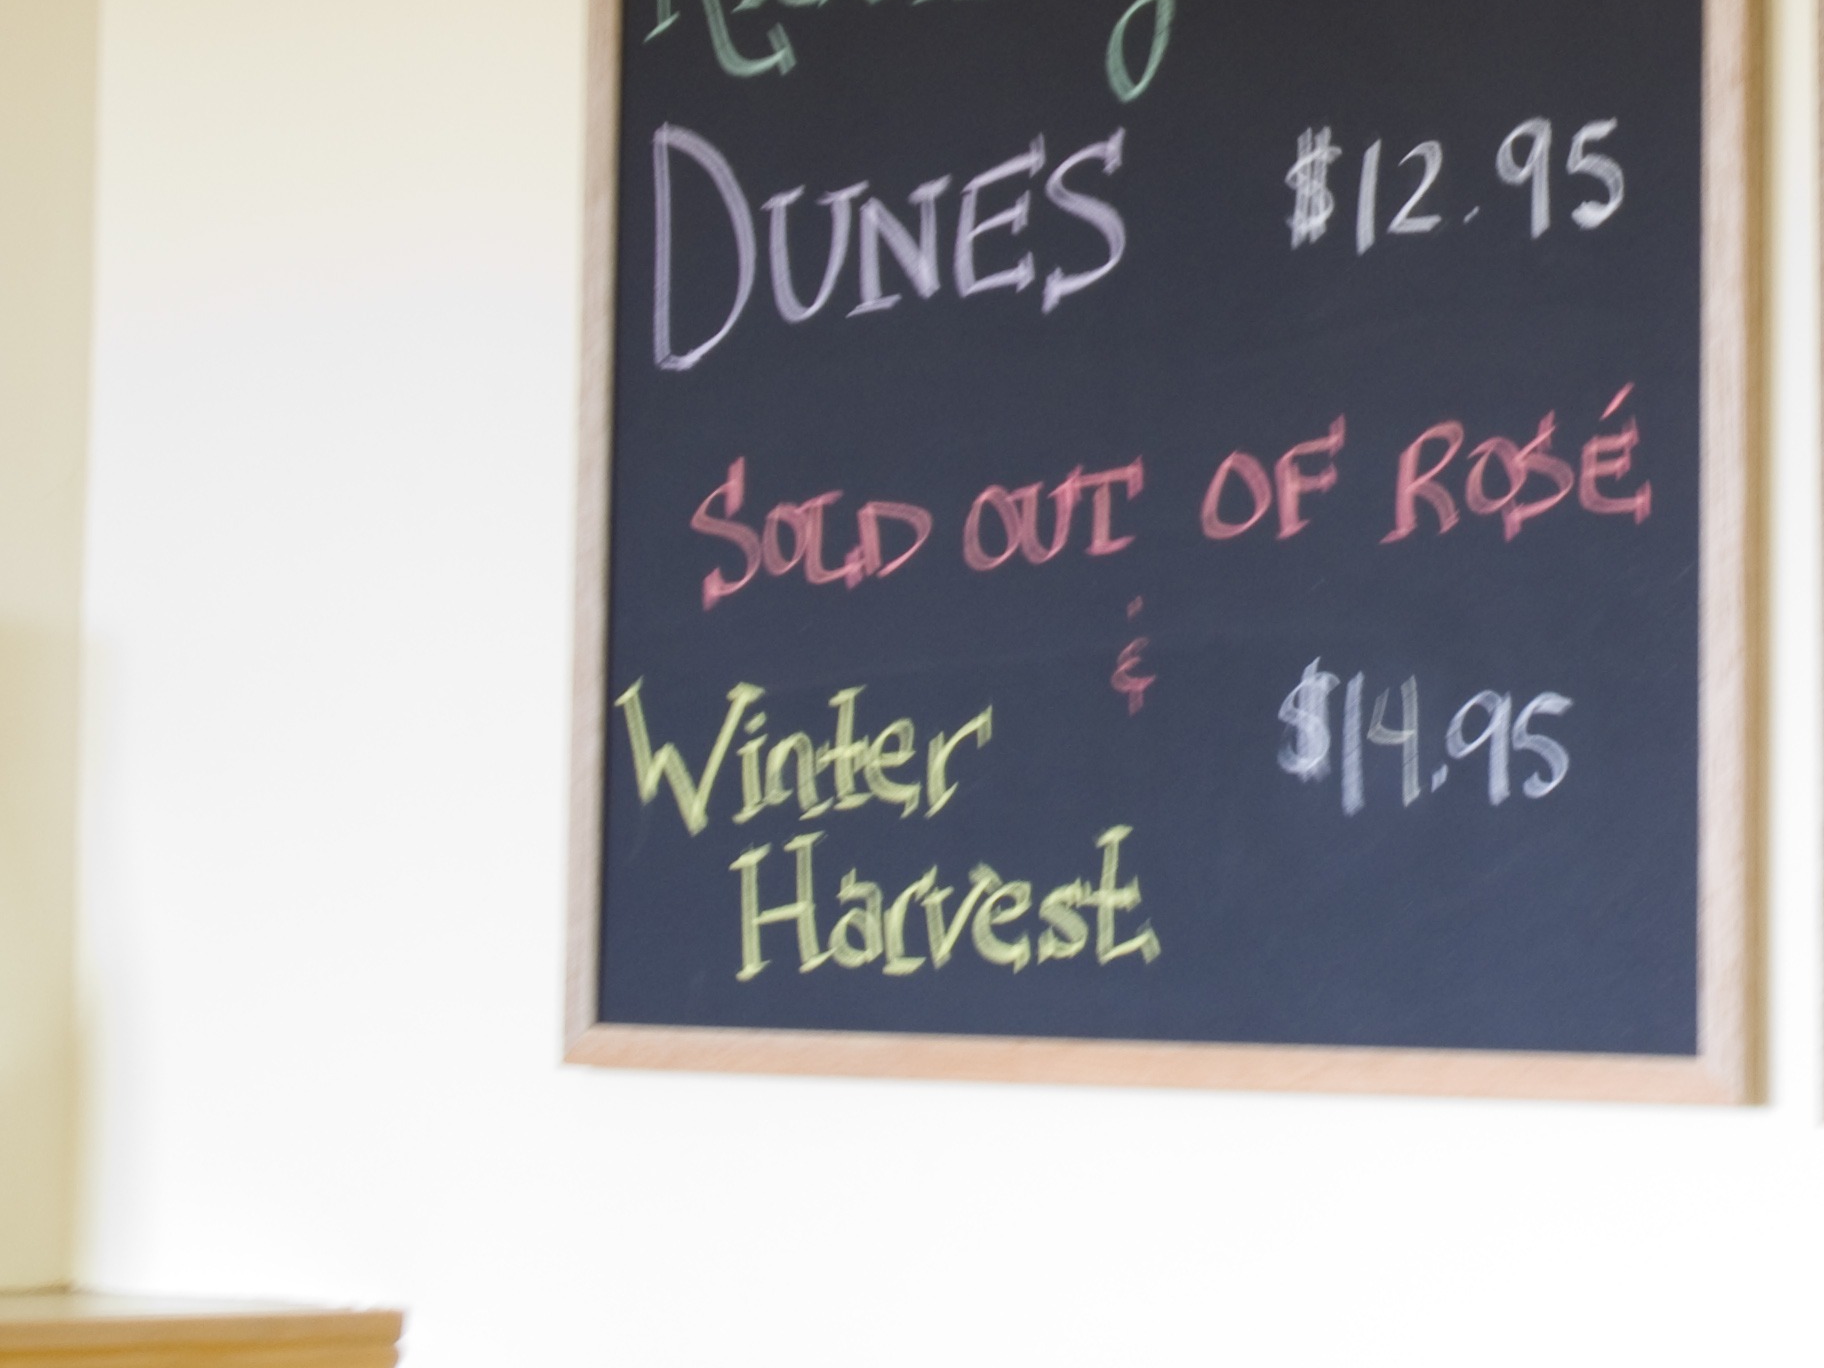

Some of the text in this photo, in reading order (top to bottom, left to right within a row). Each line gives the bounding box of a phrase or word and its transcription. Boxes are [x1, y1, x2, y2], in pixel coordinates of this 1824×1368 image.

[652, 117, 1627, 371] DUNES $12.95
[691, 456, 932, 610] SOLD
[963, 457, 1144, 574] OUT
[1201, 414, 1347, 540] OF
[615, 657, 1574, 837] Winter $14.95
[730, 825, 1161, 981] Harvest
